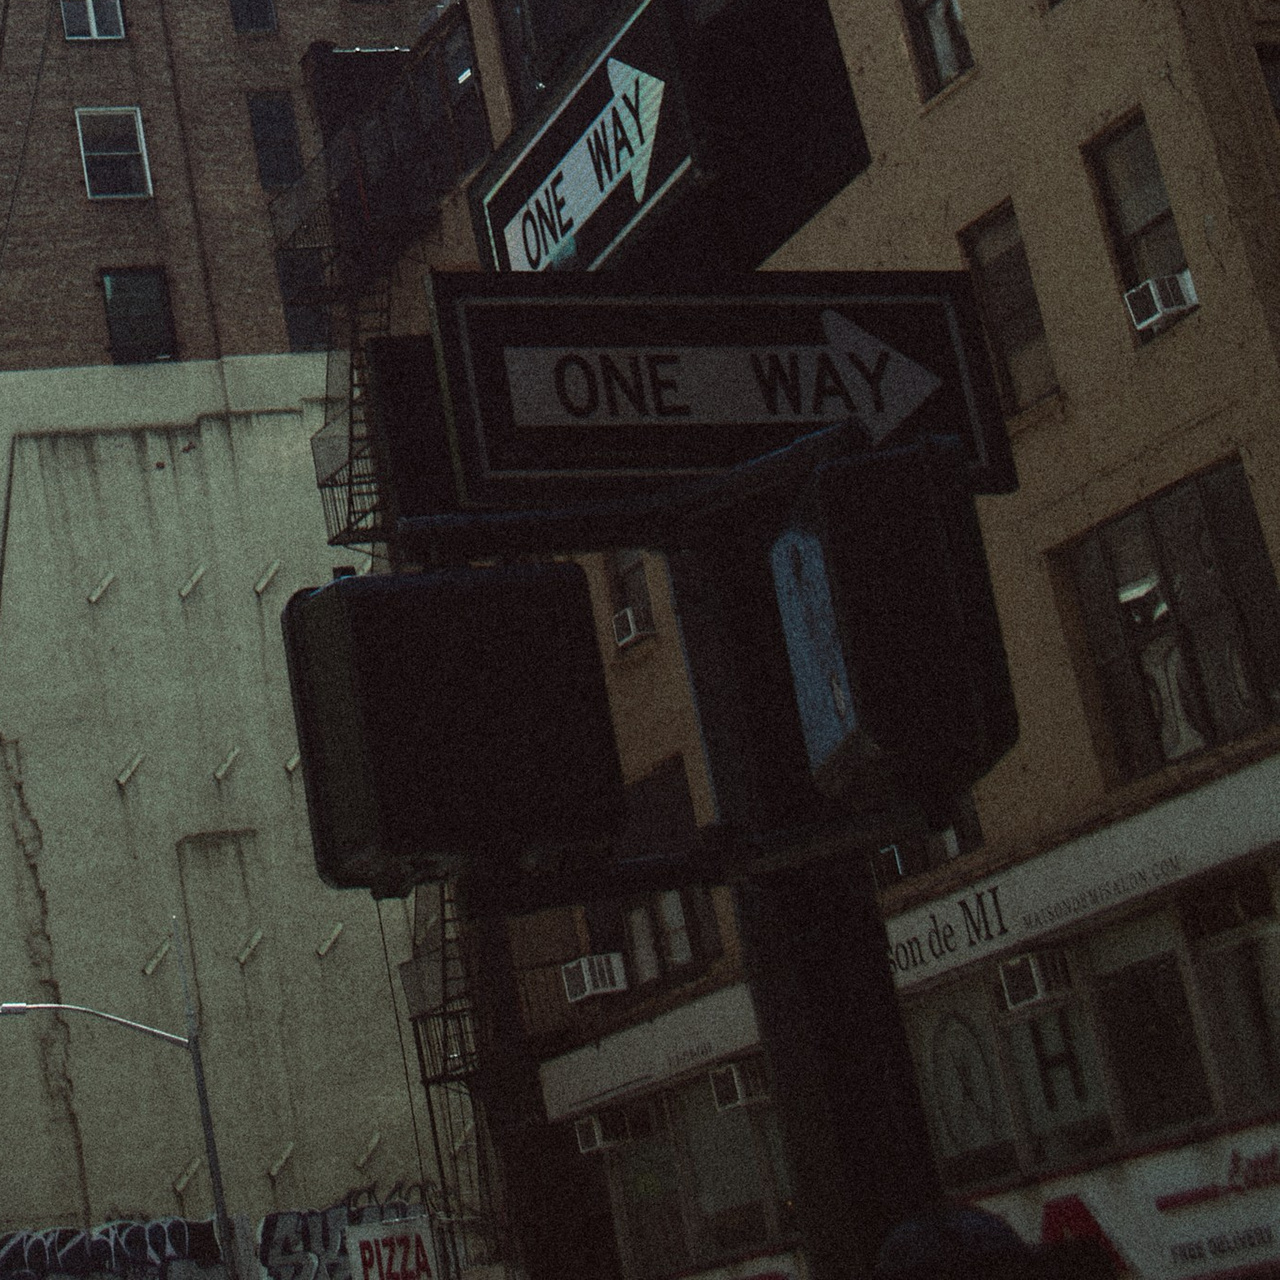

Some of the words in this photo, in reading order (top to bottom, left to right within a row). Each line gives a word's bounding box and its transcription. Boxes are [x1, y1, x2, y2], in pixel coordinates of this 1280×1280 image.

[521, 171, 574, 270] ONE
[585, 77, 651, 192] WAY
[553, 352, 692, 418] ONE
[750, 350, 892, 416] WAY
[928, 913, 957, 959] de
[958, 885, 1009, 946] MI
[358, 1233, 433, 1280] PIZZA
